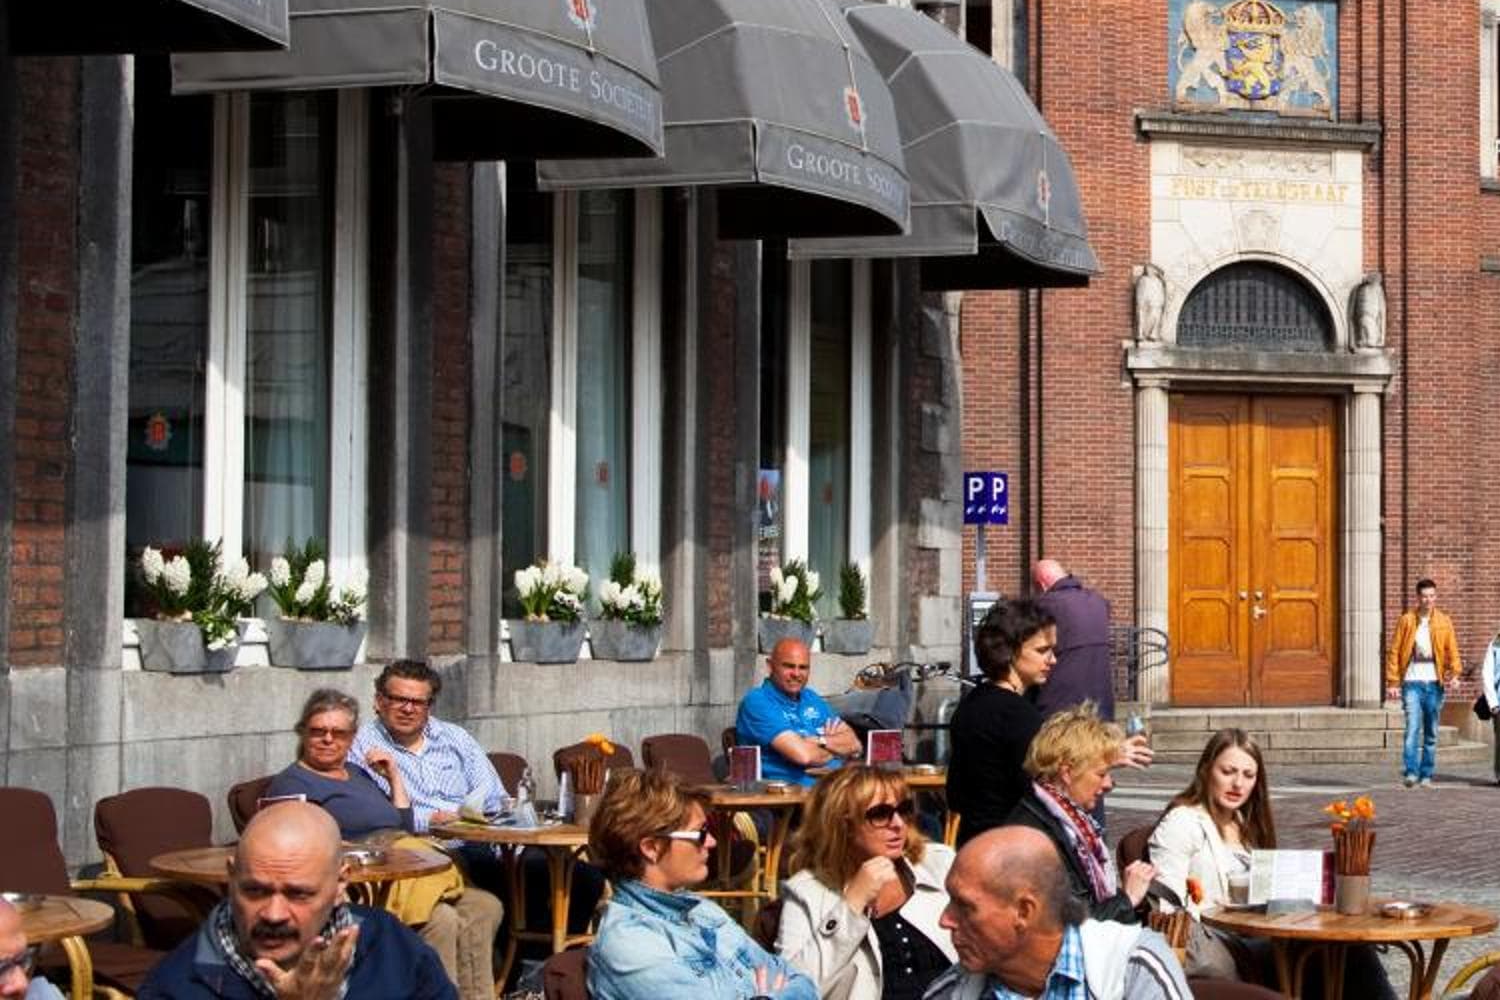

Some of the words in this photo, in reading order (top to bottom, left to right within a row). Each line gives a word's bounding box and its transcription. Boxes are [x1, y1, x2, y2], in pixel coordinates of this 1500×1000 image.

[475, 39, 582, 93] GROOTE
[787, 144, 861, 185] GROOTE
[968, 477, 985, 501] P
[992, 477, 1005, 501] P
